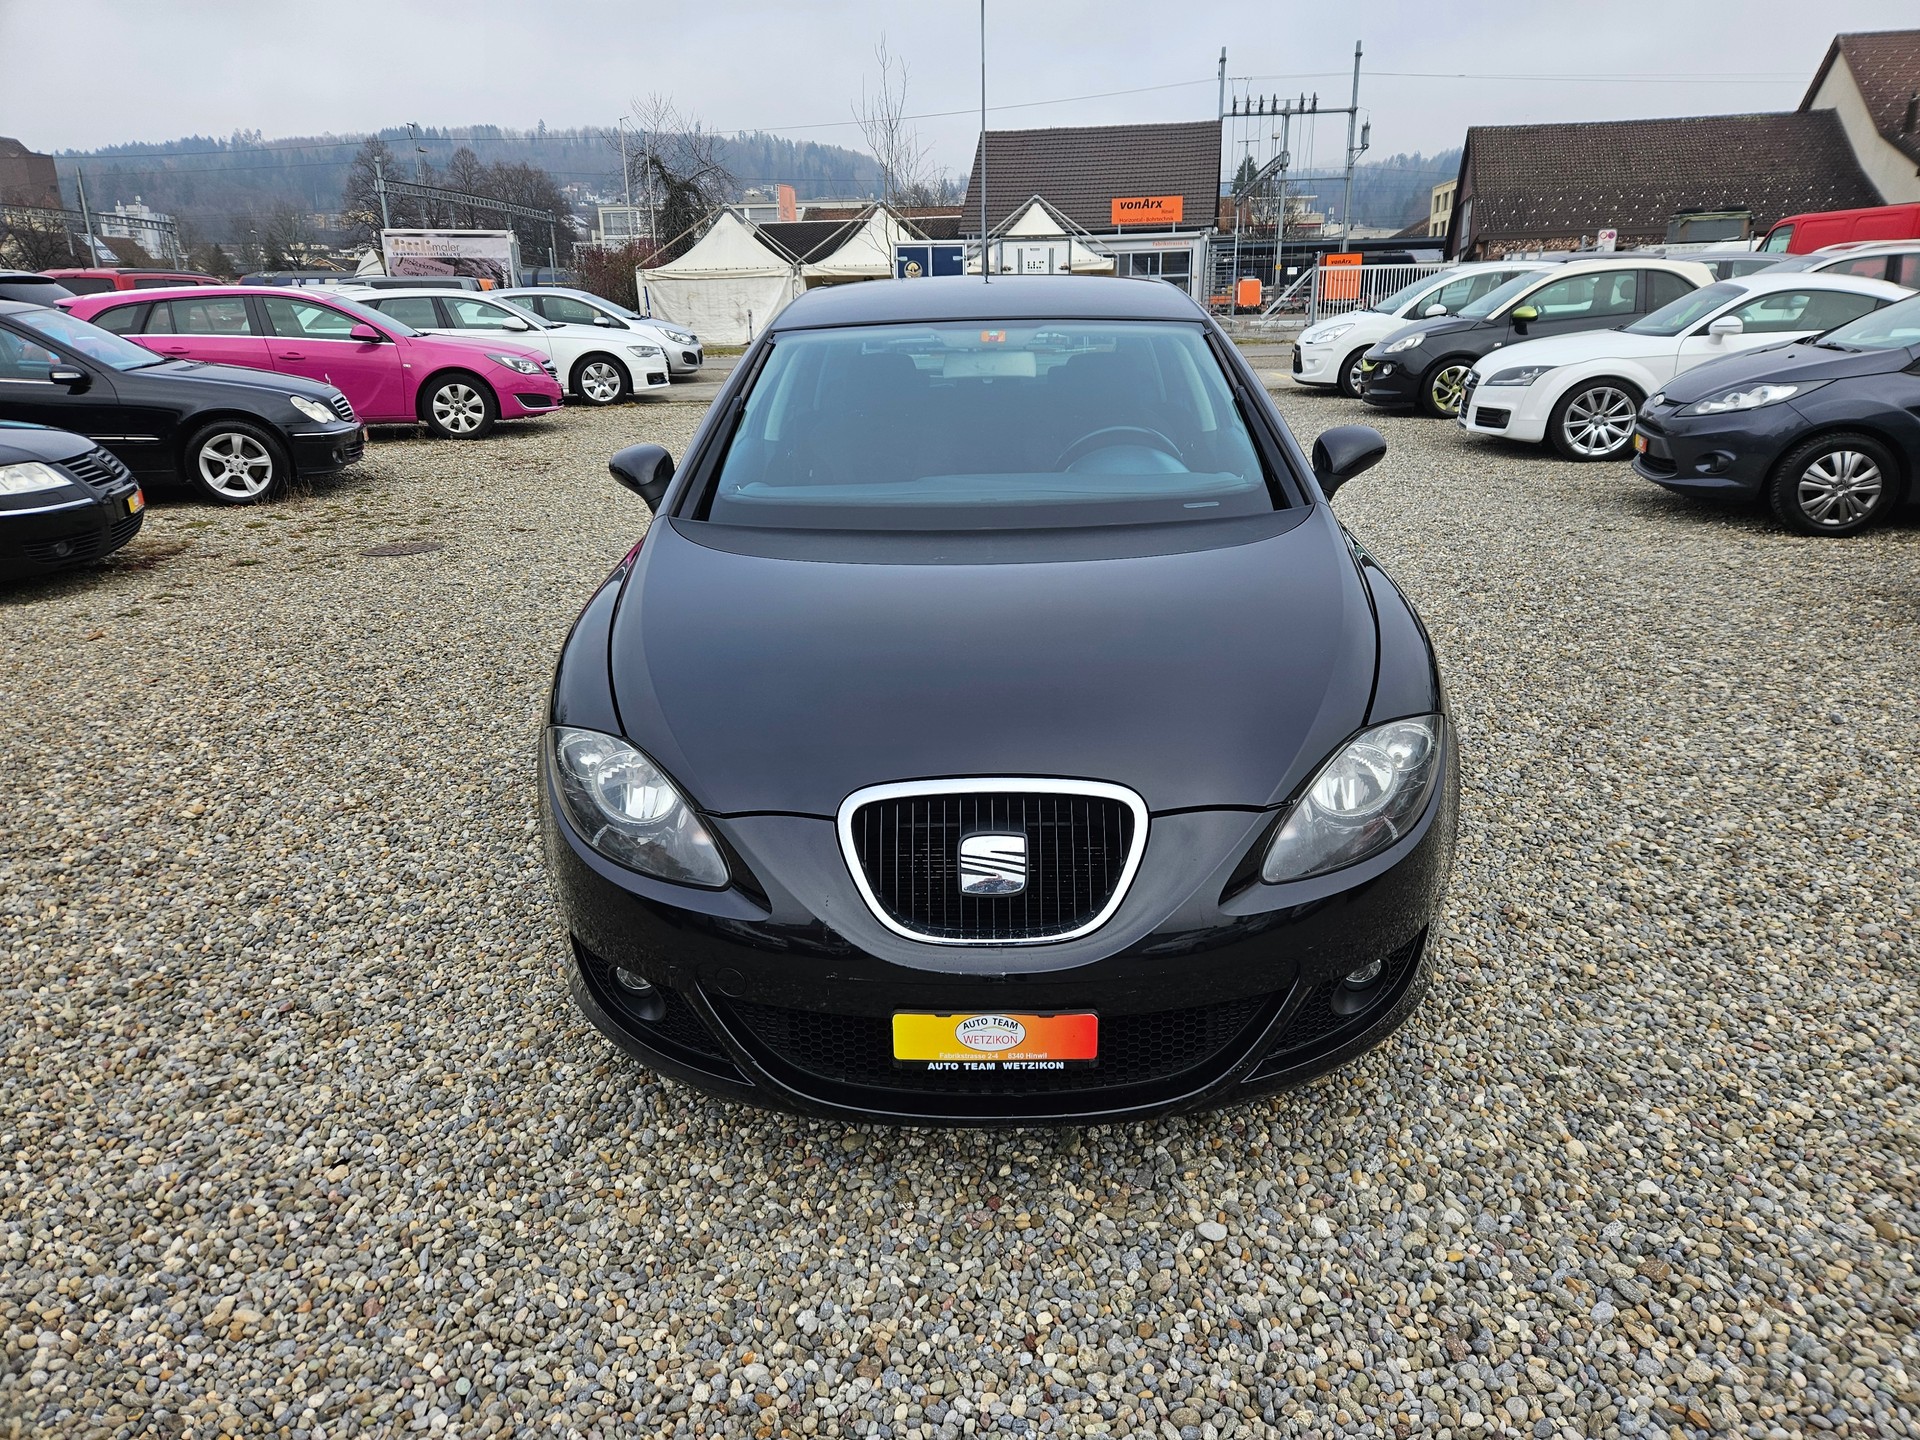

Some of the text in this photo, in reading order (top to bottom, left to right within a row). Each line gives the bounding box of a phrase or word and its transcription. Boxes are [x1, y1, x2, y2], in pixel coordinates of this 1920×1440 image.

[1120, 198, 1163, 210] vonArx
[963, 1017, 1018, 1030] AUTO TEAM
[963, 1035, 1018, 1045] WETZIKON
[927, 1061, 1065, 1071] AUTO TEAM WETZIKON
